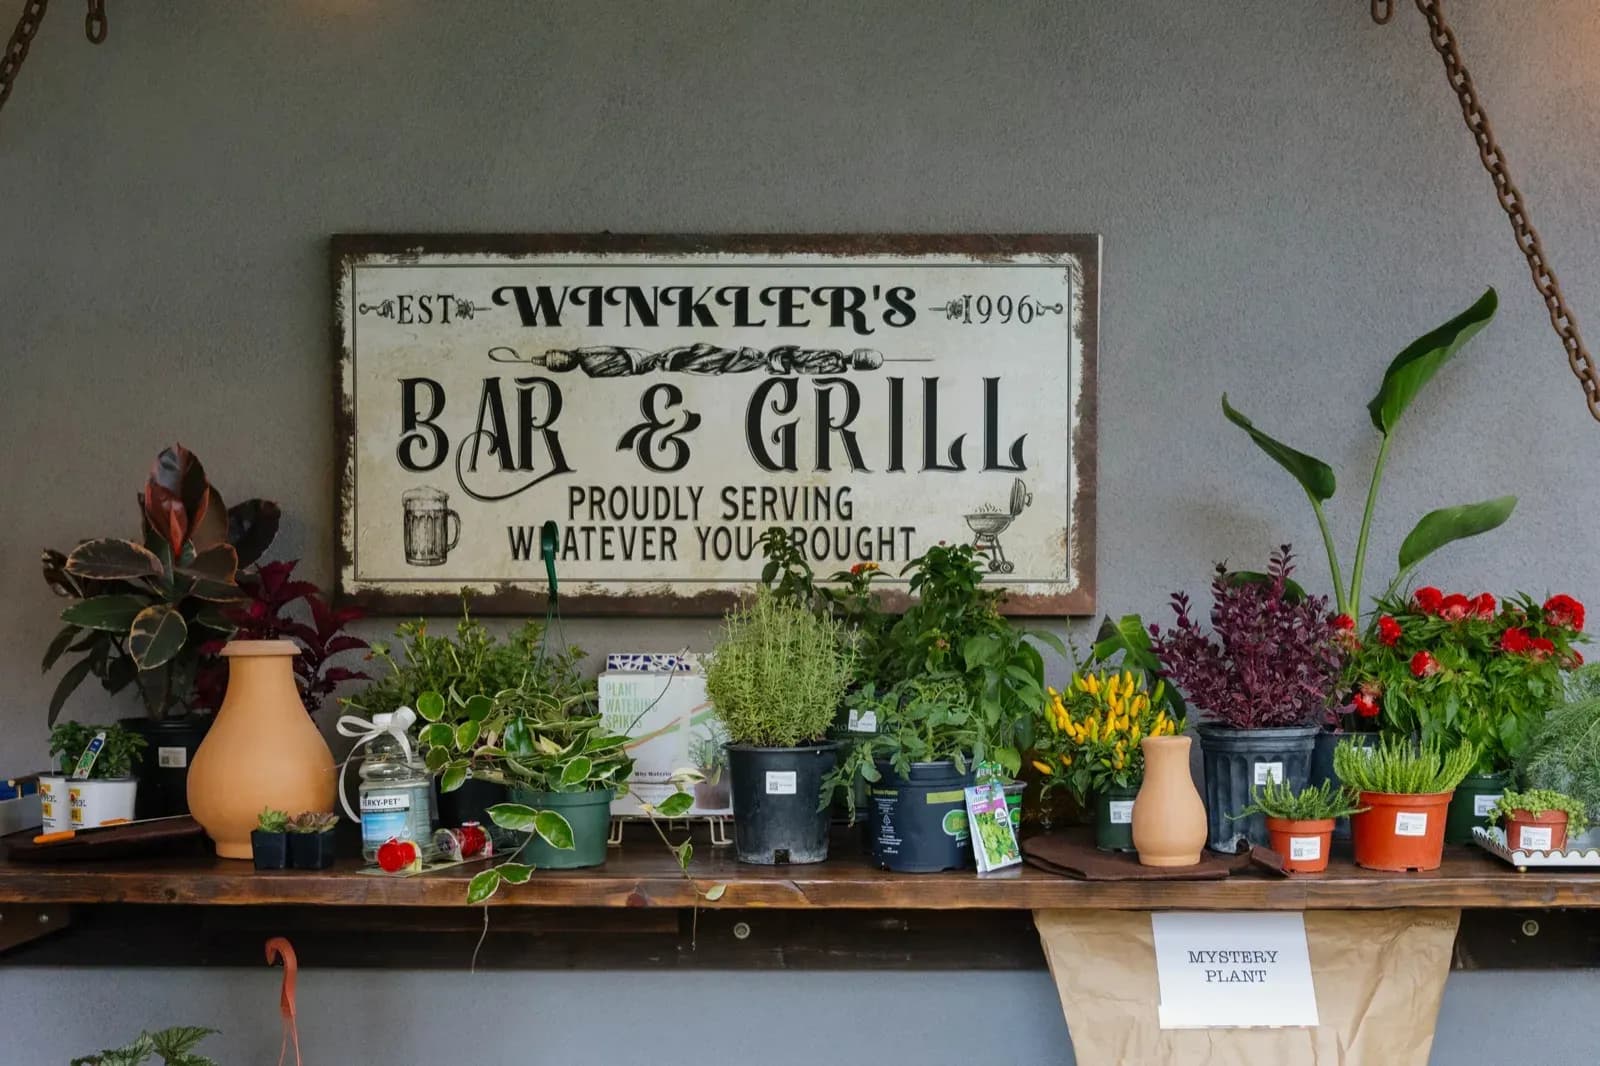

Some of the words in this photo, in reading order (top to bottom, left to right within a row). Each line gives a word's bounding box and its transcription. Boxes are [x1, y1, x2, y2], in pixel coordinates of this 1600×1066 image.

[397, 294, 455, 325] EST
[491, 285, 917, 336] WINKLER'S
[963, 294, 1034, 325] 1996
[396, 376, 577, 499] BAR
[615, 382, 702, 473] &
[744, 376, 1029, 473] GRILL
[568, 486, 704, 521] PROUDLY
[721, 486, 853, 521] SERVING
[695, 526, 753, 561] YOU
[772, 526, 916, 562] ROUGHT
[605, 681, 639, 697] PLANT
[1187, 950, 1279, 964] MYSTERY
[1205, 969, 1267, 983] PLANT
